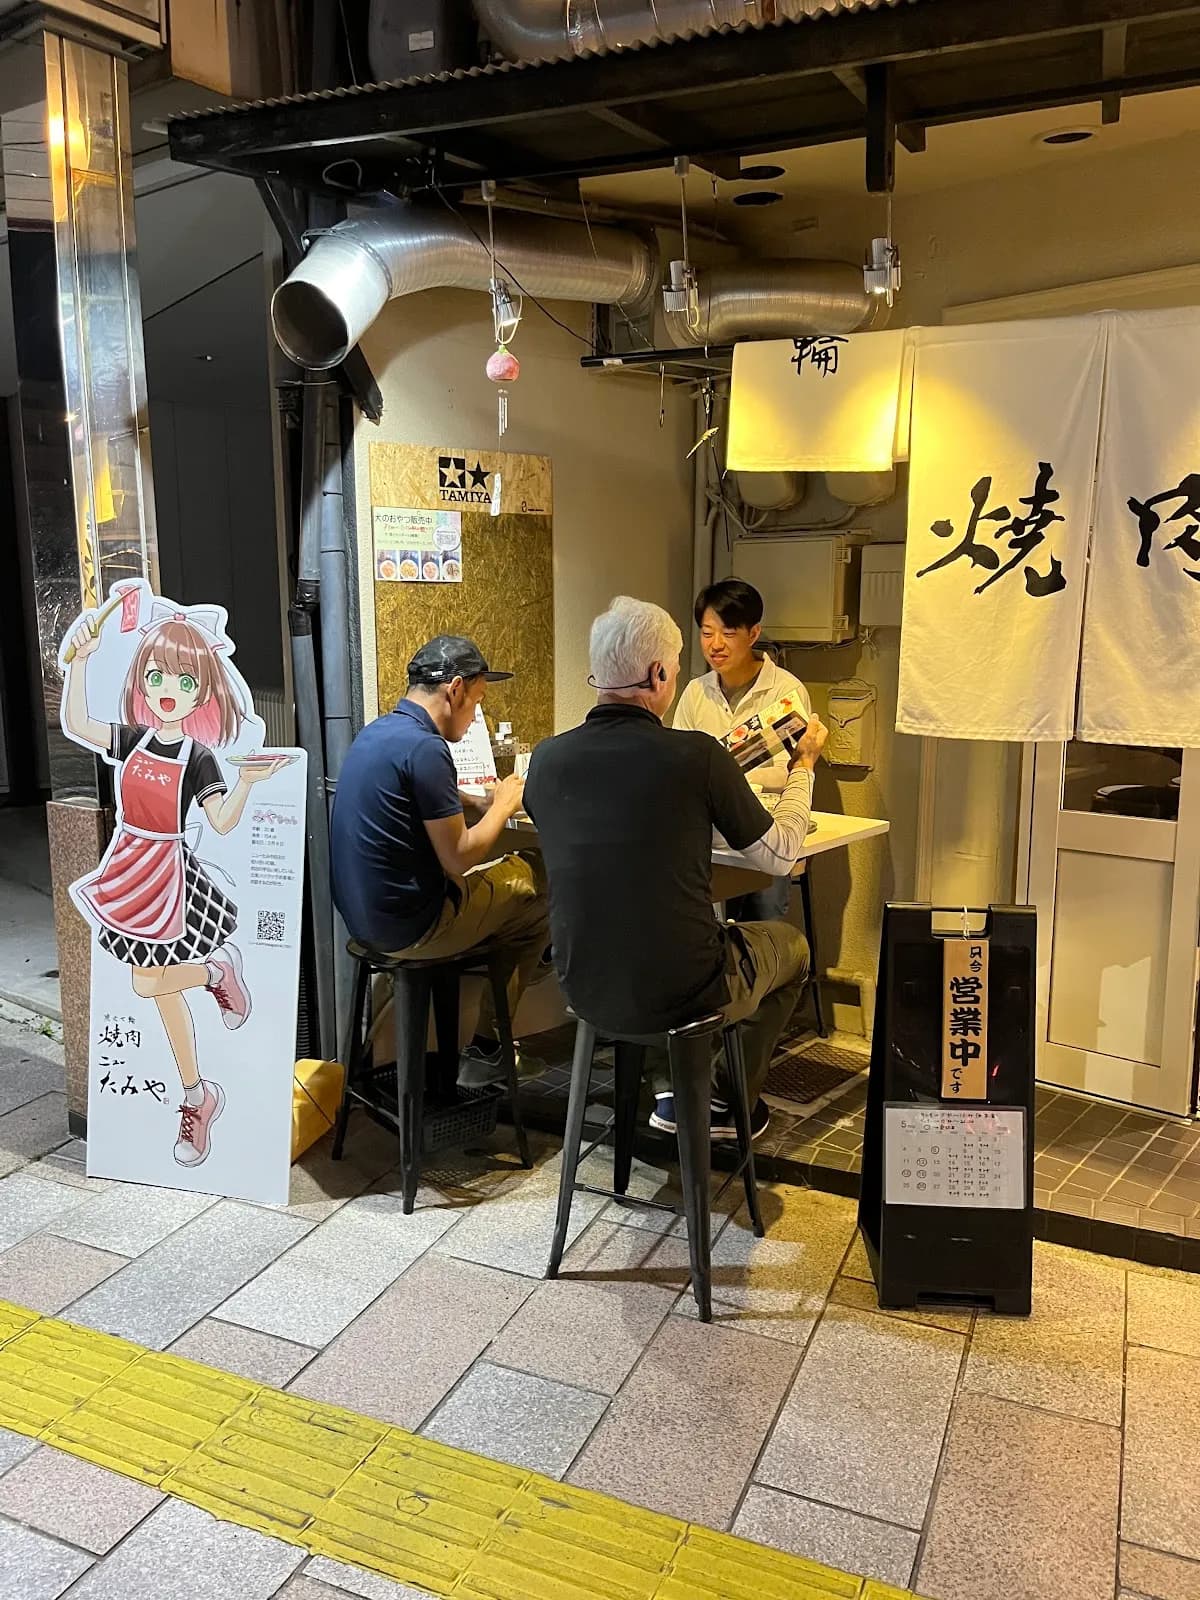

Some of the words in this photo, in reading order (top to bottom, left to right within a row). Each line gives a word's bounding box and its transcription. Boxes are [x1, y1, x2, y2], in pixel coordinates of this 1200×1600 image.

[439, 489, 493, 504] TAMIYA
[132, 765, 172, 785] たみや
[97, 1023, 141, 1048] 焼肉
[98, 1055, 126, 1067] ニュー
[100, 1071, 166, 1102] たみや
